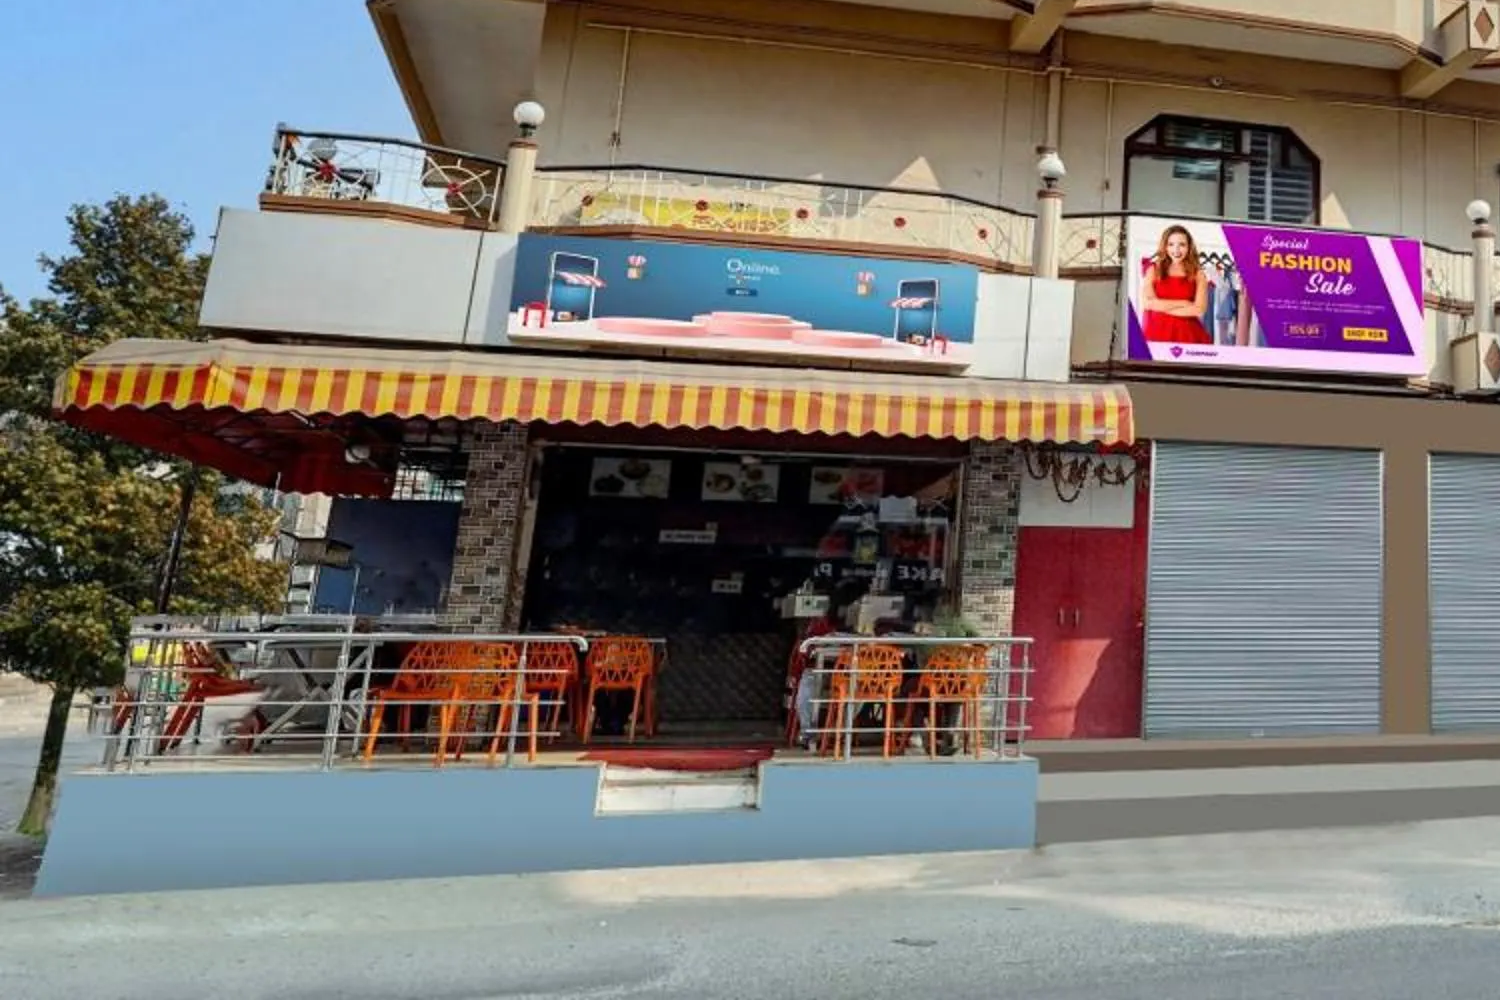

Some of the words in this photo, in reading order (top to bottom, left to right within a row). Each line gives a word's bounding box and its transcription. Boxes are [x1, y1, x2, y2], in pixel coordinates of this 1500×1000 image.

[1261, 233, 1310, 251] Special
[1259, 251, 1352, 274] FASHION
[1305, 272, 1357, 295] Sale
